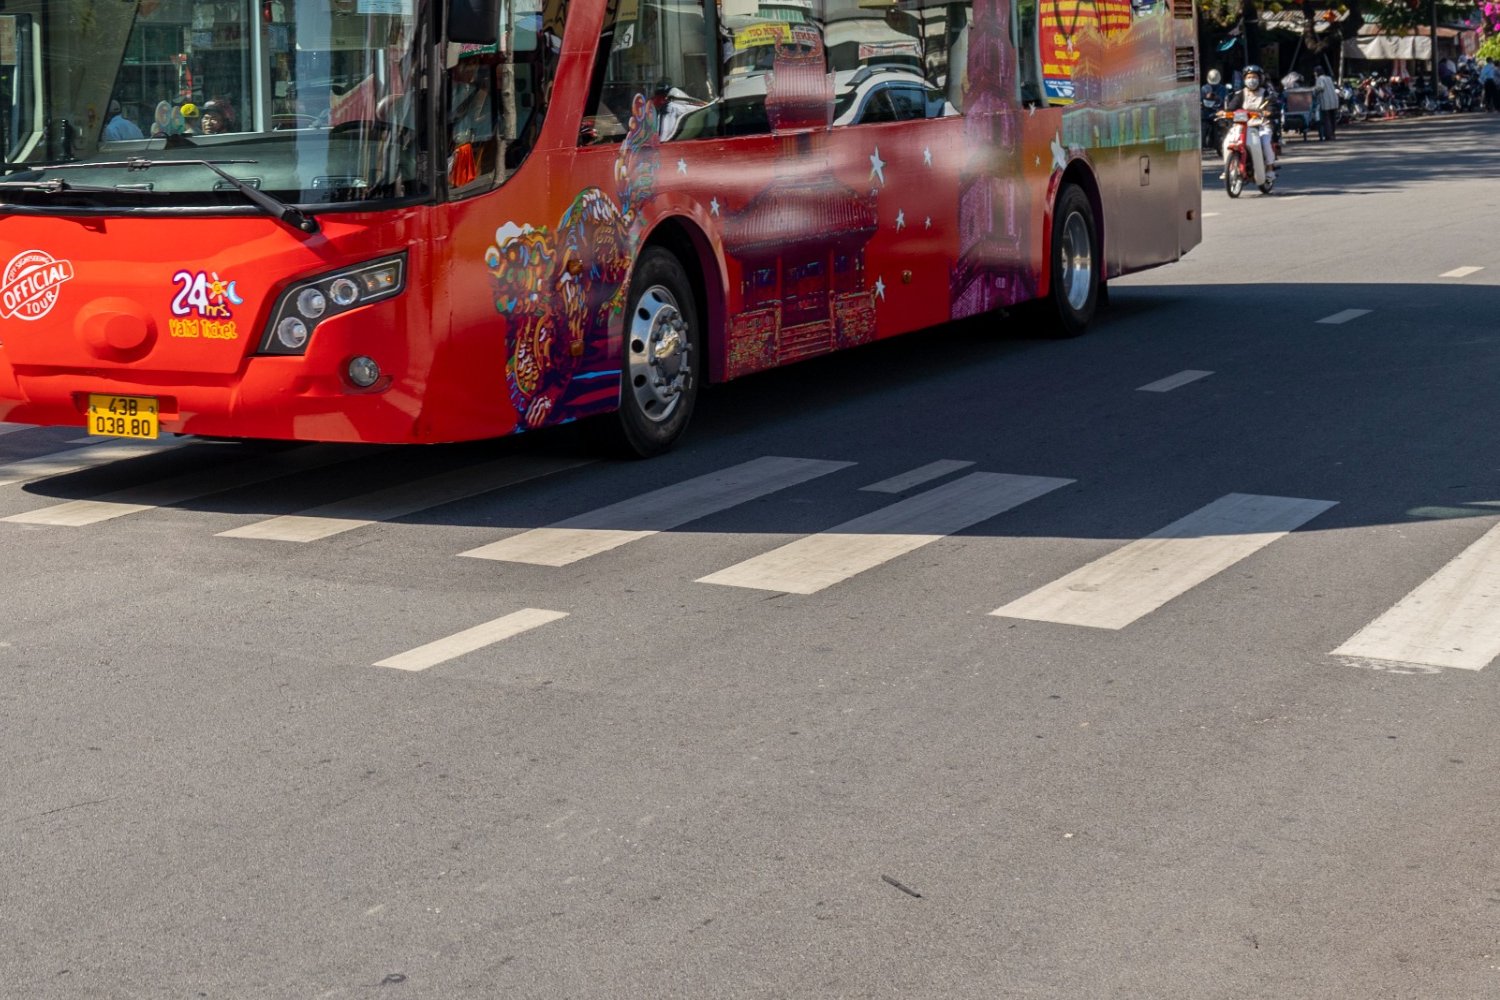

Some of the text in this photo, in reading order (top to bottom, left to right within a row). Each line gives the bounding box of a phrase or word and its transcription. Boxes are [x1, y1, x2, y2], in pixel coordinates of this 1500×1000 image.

[3, 263, 69, 310] OFFICIAL
[171, 271, 209, 315] 24
[26, 290, 56, 314] TOUR
[168, 318, 238, 340] Valid Ticket
[109, 398, 137, 416] 43B
[96, 416, 150, 436] 038.80
